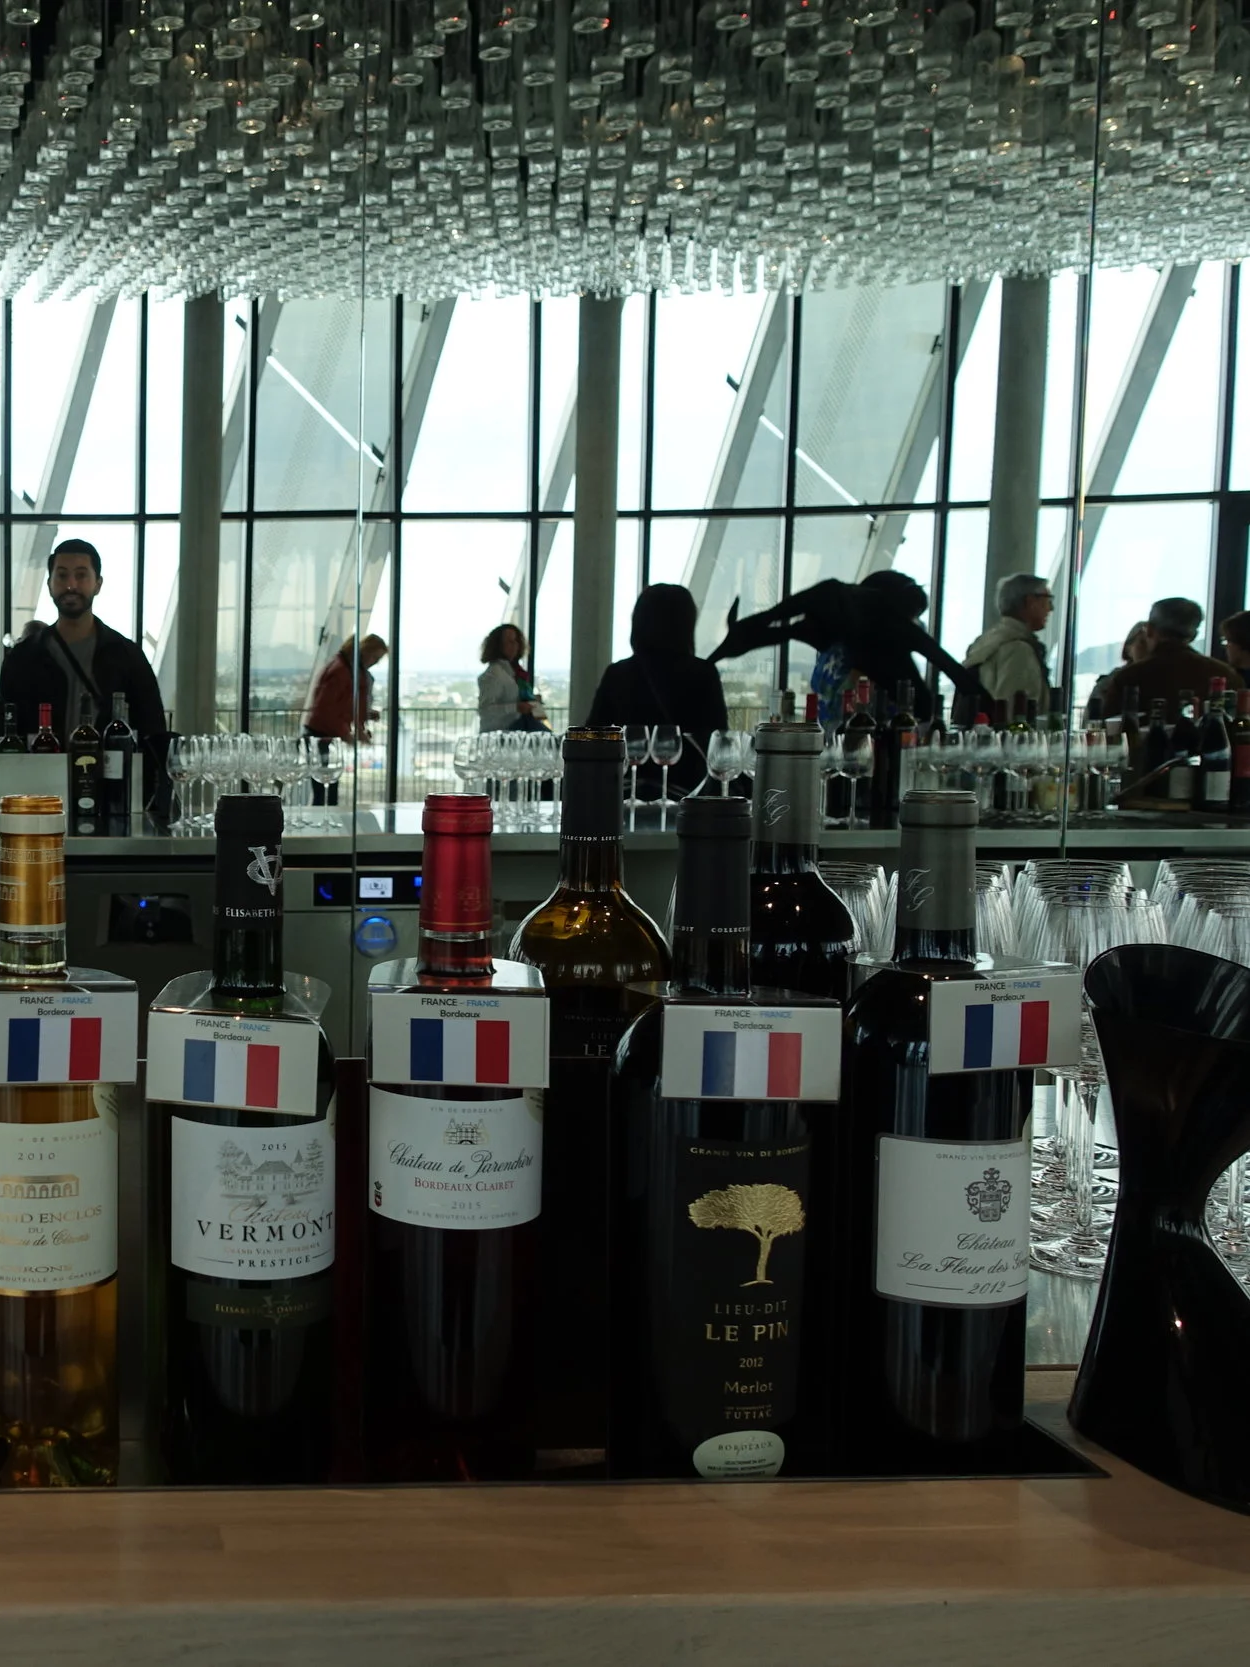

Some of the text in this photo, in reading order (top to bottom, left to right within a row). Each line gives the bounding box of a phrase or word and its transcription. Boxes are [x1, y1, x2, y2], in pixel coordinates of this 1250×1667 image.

[225, 906, 276, 918] ELISABETH
[975, 981, 1041, 991] FRANCE FRANCE
[20, 996, 54, 1004] FRANCE
[421, 998, 457, 1006] FRANCE
[991, 994, 1025, 1002] Bordeaux
[37, 1008, 75, 1016] Bordeaux
[440, 1010, 480, 1018] Bordeaux
[714, 1009, 793, 1018] FRANCE FRANCE
[195, 1019, 270, 1031] FRANCE FRANCE
[733, 1021, 773, 1030] Bordeaux
[213, 1031, 252, 1041] Bordeaux
[583, 1043, 607, 1057] LE
[262, 1143, 287, 1151] 2015
[690, 1147, 729, 1156] GRAND
[18, 1153, 55, 1161] 2010
[388, 1140, 443, 1173] Château
[449, 1161, 466, 1174] de
[936, 1153, 967, 1161] GRAND
[412, 1177, 514, 1193] BORDEAUX CLAIRET
[451, 1202, 481, 1210] 2015
[39, 1205, 102, 1224] ENCLOS
[197, 1211, 333, 1242] VERMONT
[32, 1234, 47, 1247] de
[957, 1233, 1015, 1251] Château
[238, 1255, 311, 1267] PRESTIGE
[897, 1252, 932, 1272] La
[935, 1255, 985, 1274] Fleur
[987, 1259, 1008, 1273] des
[0, 1275, 47, 1283] BOUTEILLE
[967, 1281, 1006, 1295] 2012
[714, 1300, 788, 1316] LIEU-DIT
[705, 1320, 789, 1342] LE PIN
[739, 1357, 763, 1368] 2012
[724, 1380, 773, 1395] Merlot
[724, 1409, 772, 1420] TUTIAC
